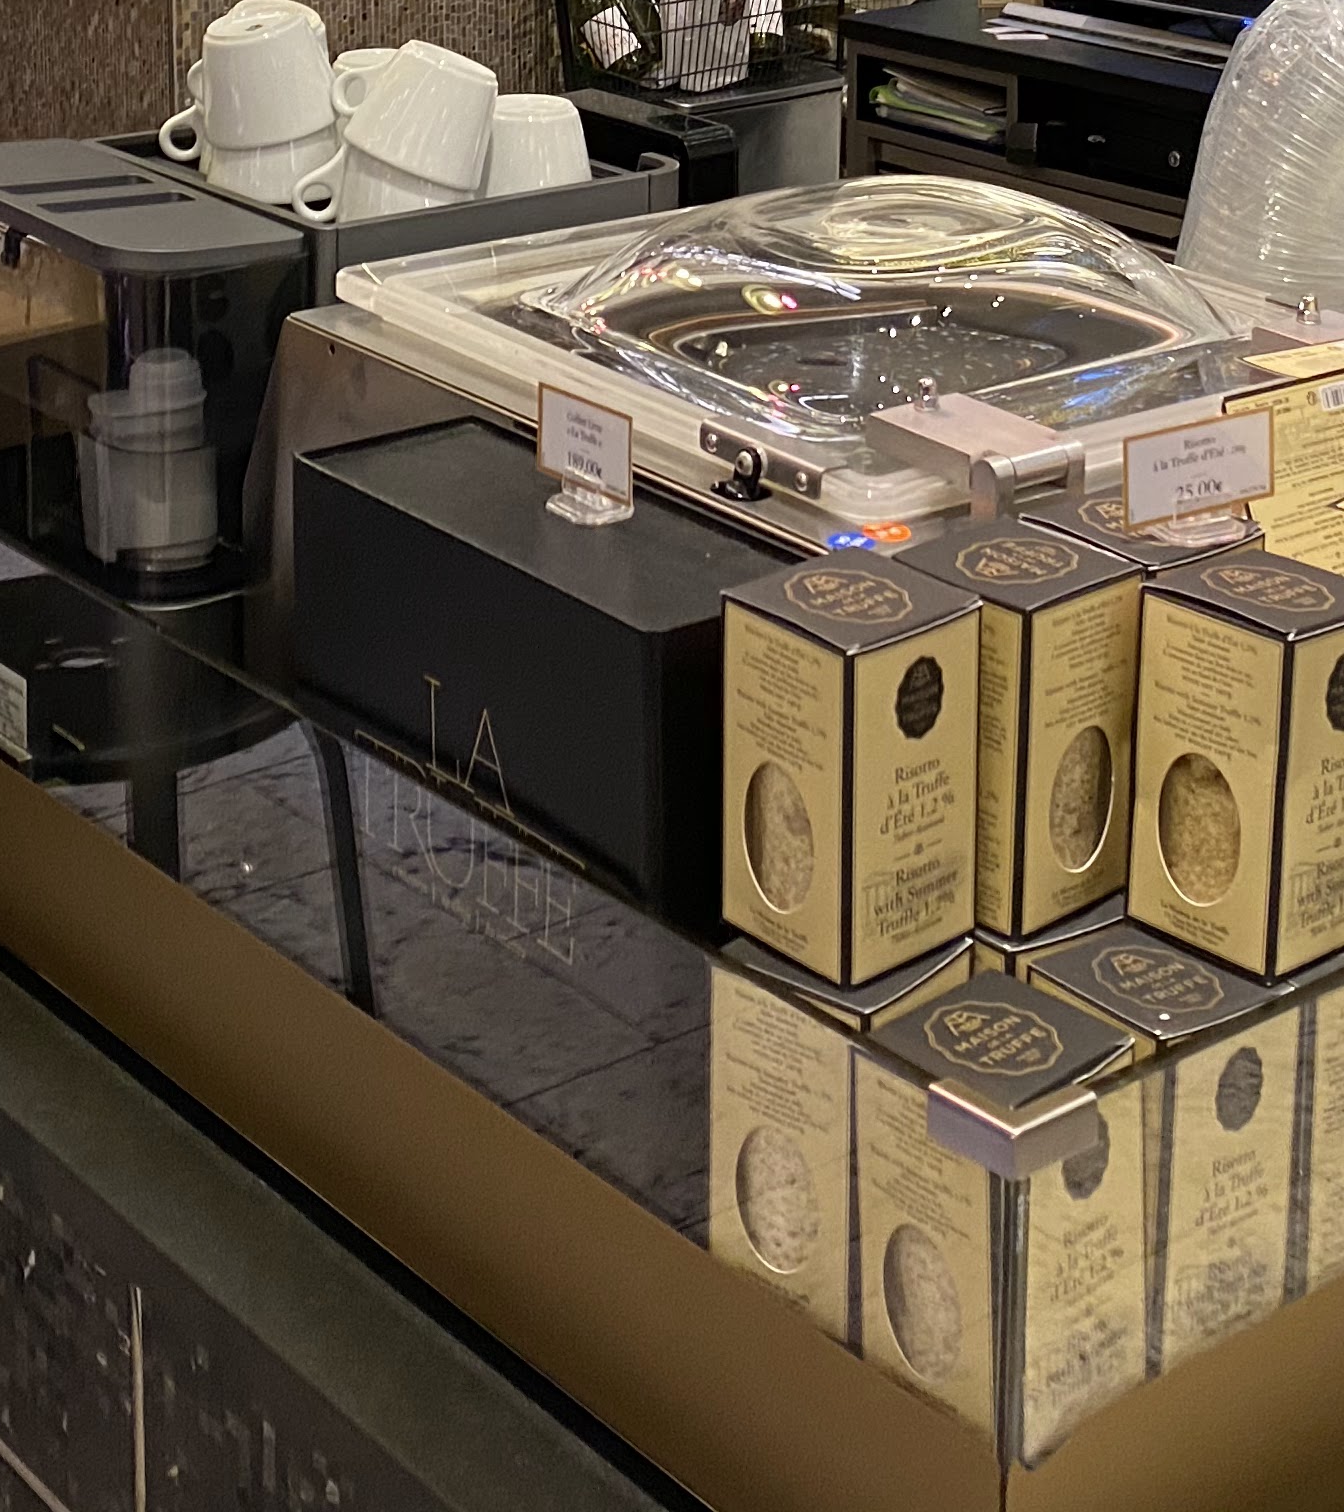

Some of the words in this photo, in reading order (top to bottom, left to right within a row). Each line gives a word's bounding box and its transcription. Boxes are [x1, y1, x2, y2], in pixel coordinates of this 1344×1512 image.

[423, 675, 515, 818] LA
[887, 793, 895, 811] à
[899, 788, 910, 806] la
[912, 770, 951, 800] Truffe
[895, 758, 941, 785] Risotto
[880, 806, 915, 835] d'Été
[355, 728, 586, 965] TRUFFE
[1119, 961, 1185, 991] MAISON
[1142, 974, 1209, 1004] TRUFFE
[953, 1014, 1022, 1054] MAISON
[978, 1026, 1048, 1066] TRUFFE
